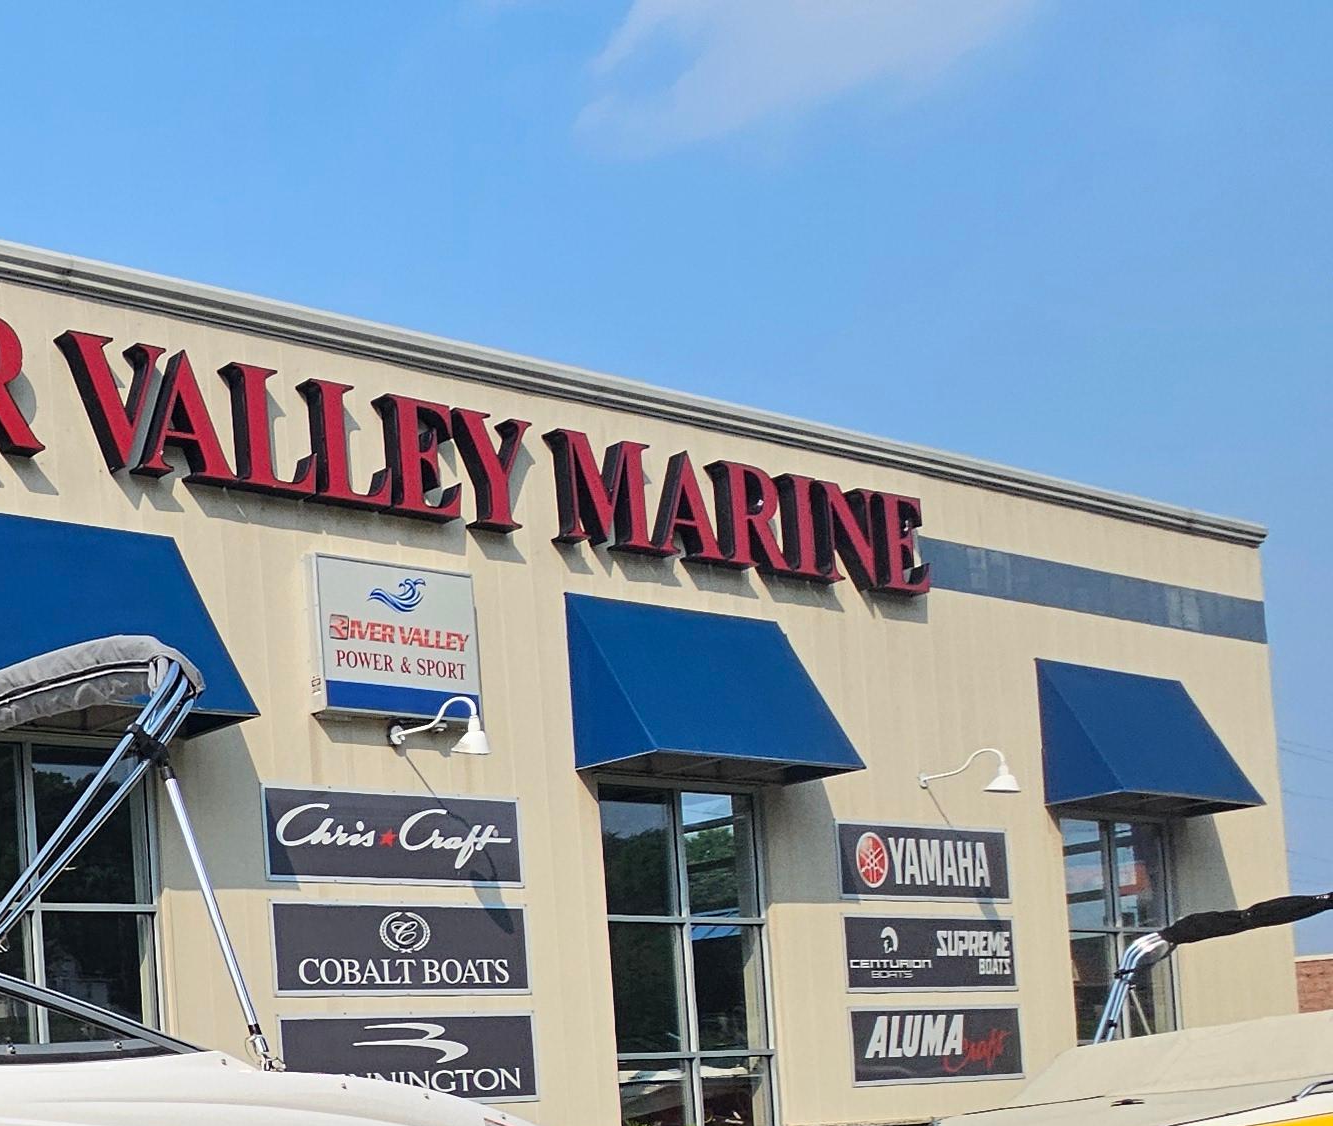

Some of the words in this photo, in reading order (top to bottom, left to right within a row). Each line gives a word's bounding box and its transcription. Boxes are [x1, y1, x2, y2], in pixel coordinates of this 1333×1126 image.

[53, 330, 531, 534] VALLEY
[541, 428, 930, 596] MARINE
[329, 613, 395, 643] RIVER
[399, 626, 469, 652] VALLEY
[336, 650, 394, 672] POWER
[400, 656, 411, 674] &
[417, 658, 467, 680] SPORT
[275, 803, 375, 847] Chris
[399, 808, 512, 869] Craft
[888, 837, 991, 887] YAMAHA
[936, 930, 1010, 957] SUPREME
[298, 958, 416, 985] COBALT
[422, 959, 510, 985] BOATS
[850, 959, 932, 969] CENTURION
[871, 970, 914, 979] BOATS
[978, 958, 1011, 975] BOATS
[864, 1014, 964, 1059] ALUMA
[342, 1067, 521, 1093] INGTON
